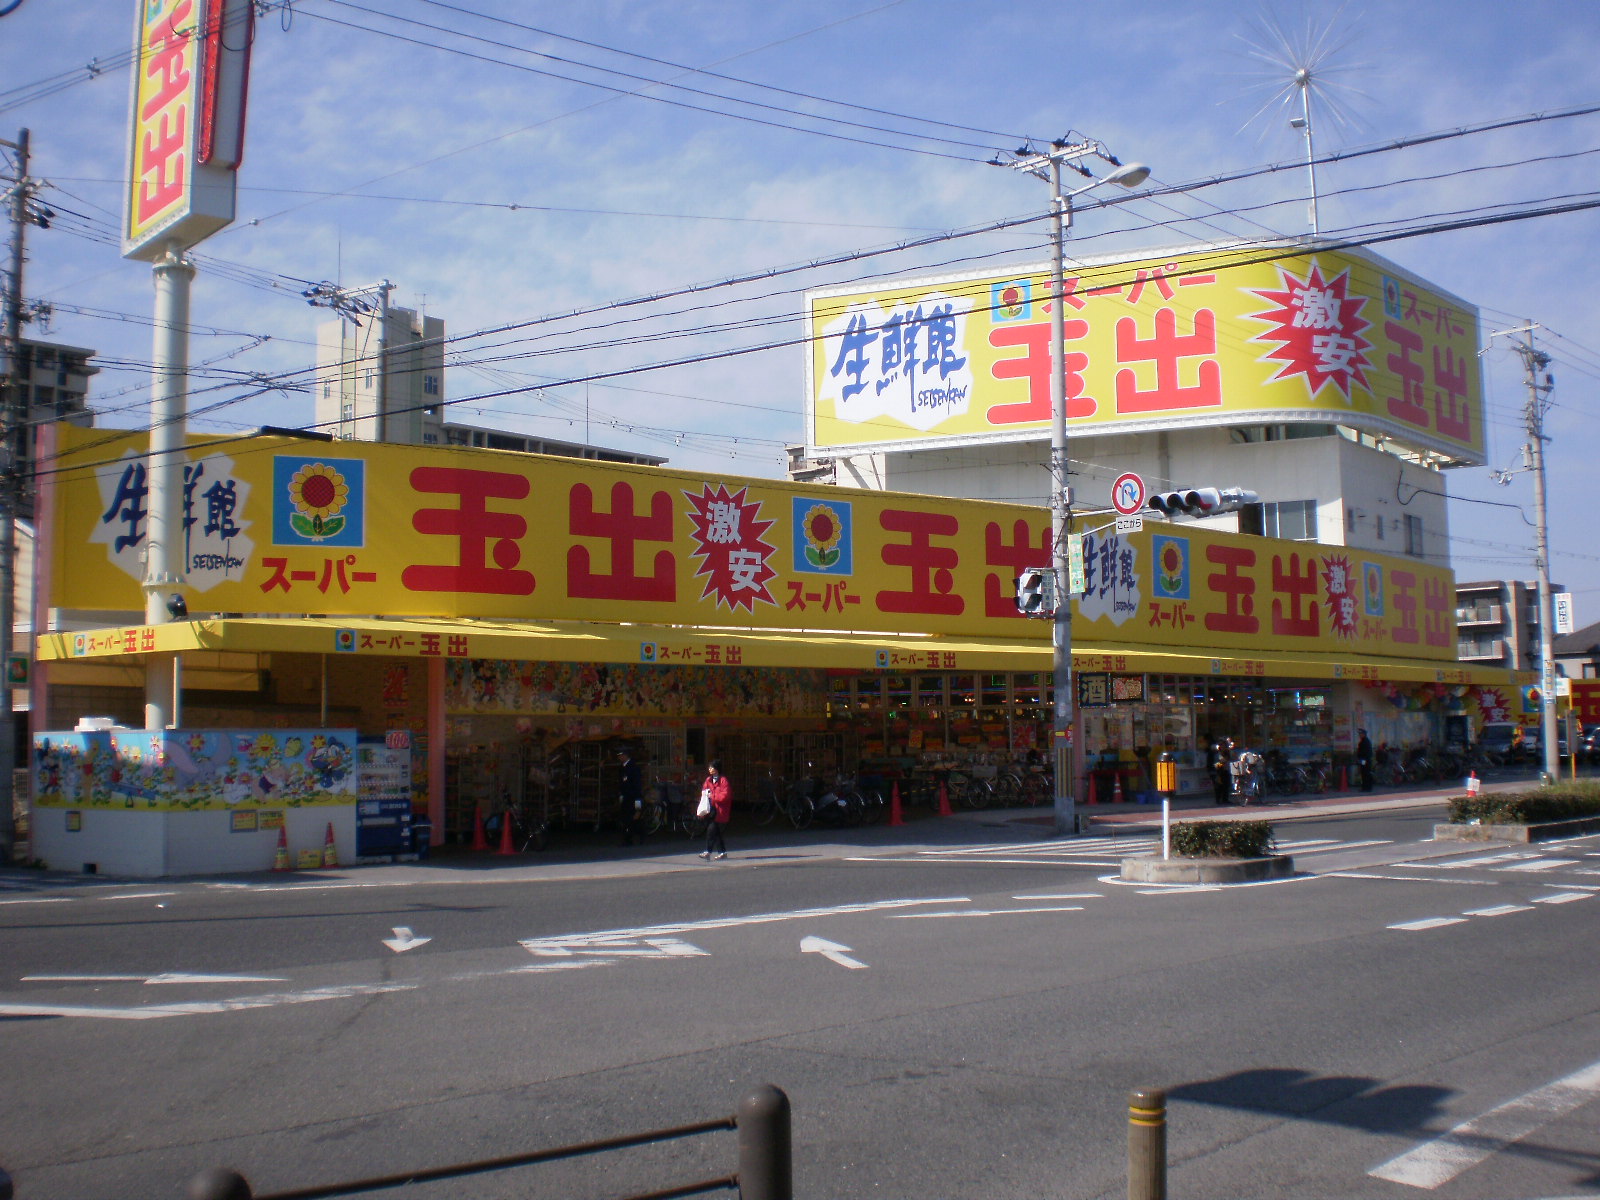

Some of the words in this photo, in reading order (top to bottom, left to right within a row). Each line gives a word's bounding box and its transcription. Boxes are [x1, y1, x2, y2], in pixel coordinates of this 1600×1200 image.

[831, 304, 967, 412] 生鮮館
[987, 307, 1221, 424] 玉出
[1291, 287, 1357, 375] 激安
[1385, 320, 1472, 443] 玉出
[402, 466, 677, 603] 玉出
[706, 501, 762, 592] 激安
[1117, 518, 1142, 530] ここから
[260, 555, 377, 594] スーパー
[786, 580, 861, 613] スーパー
[1149, 602, 1196, 630] スーパー
[1205, 543, 1321, 637] 玉出
[1330, 565, 1354, 626] 激安
[1390, 569, 1452, 649] 玉出
[1080, 675, 1106, 704] 酒
